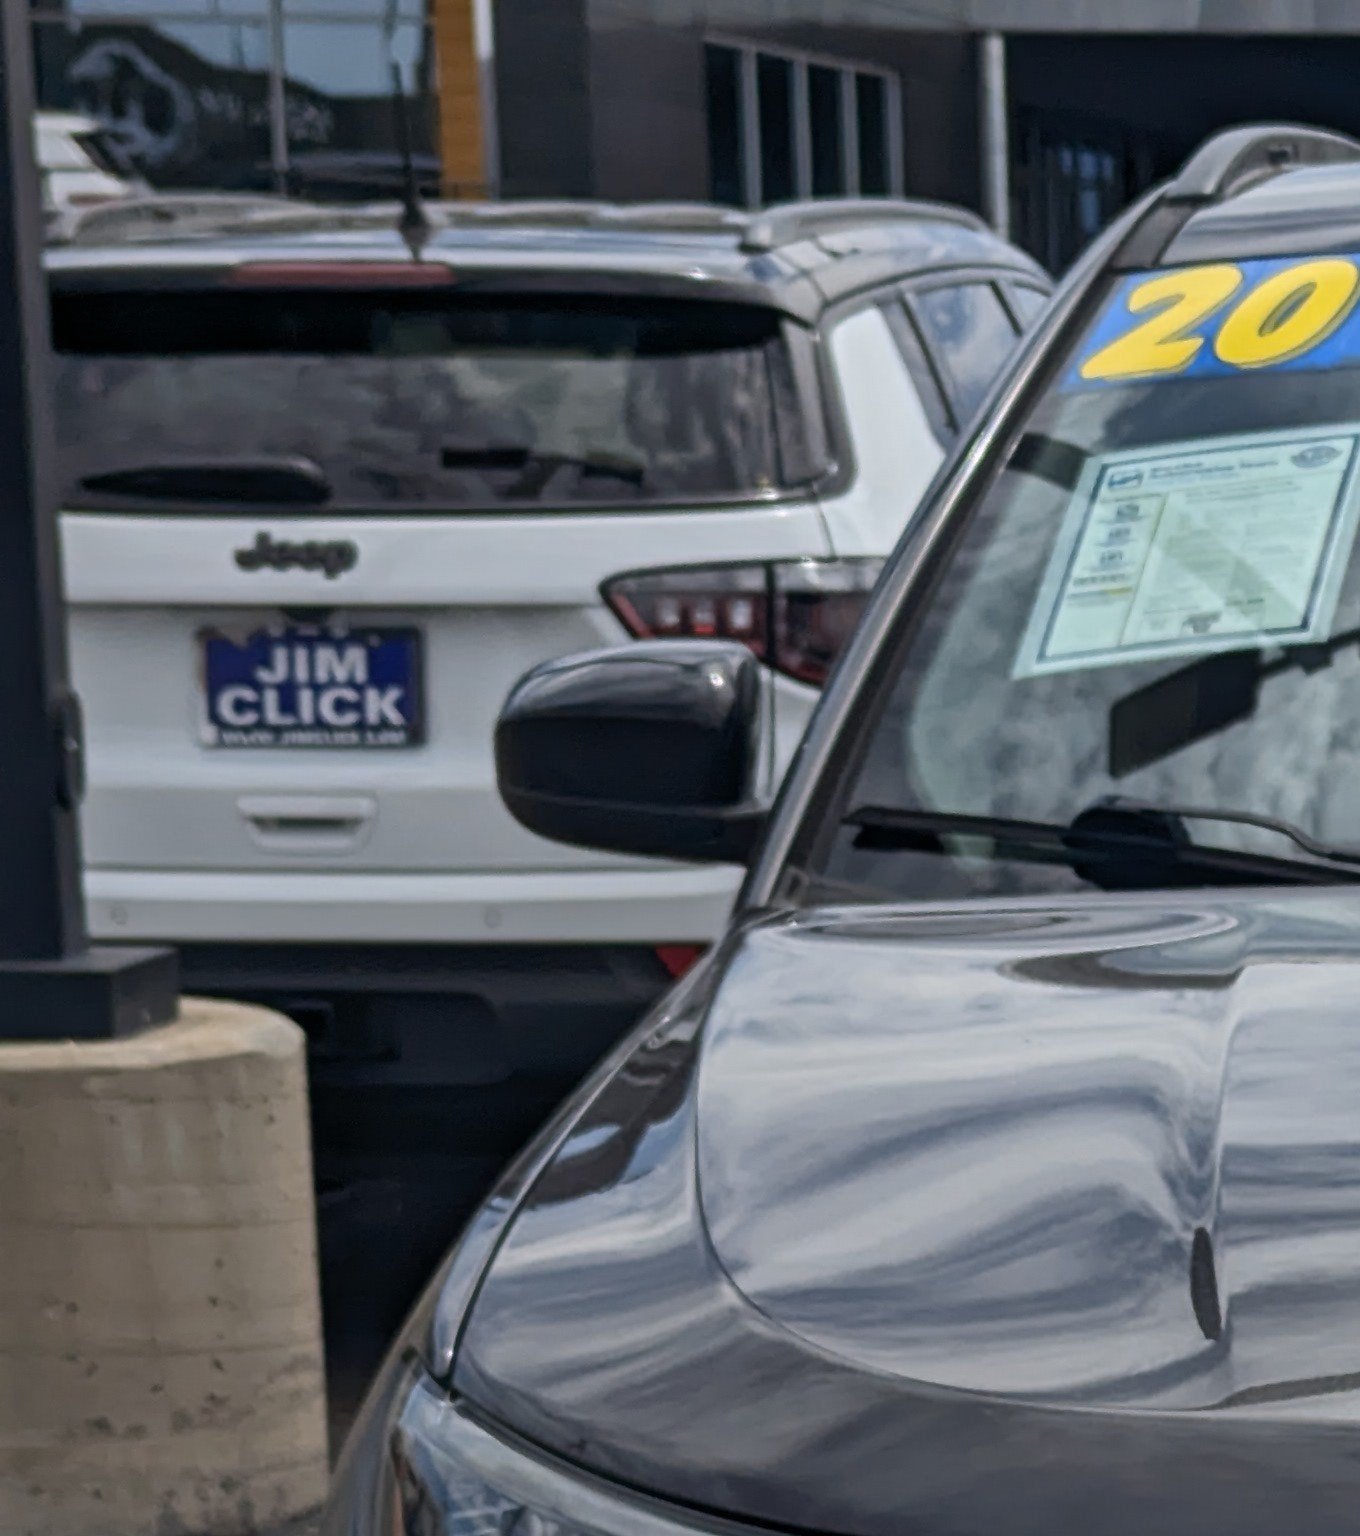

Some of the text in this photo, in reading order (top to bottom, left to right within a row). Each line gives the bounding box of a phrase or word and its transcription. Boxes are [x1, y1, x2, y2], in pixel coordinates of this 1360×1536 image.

[233, 530, 359, 580] Jeep
[254, 642, 369, 685] JIM
[216, 684, 407, 727] CLICK
